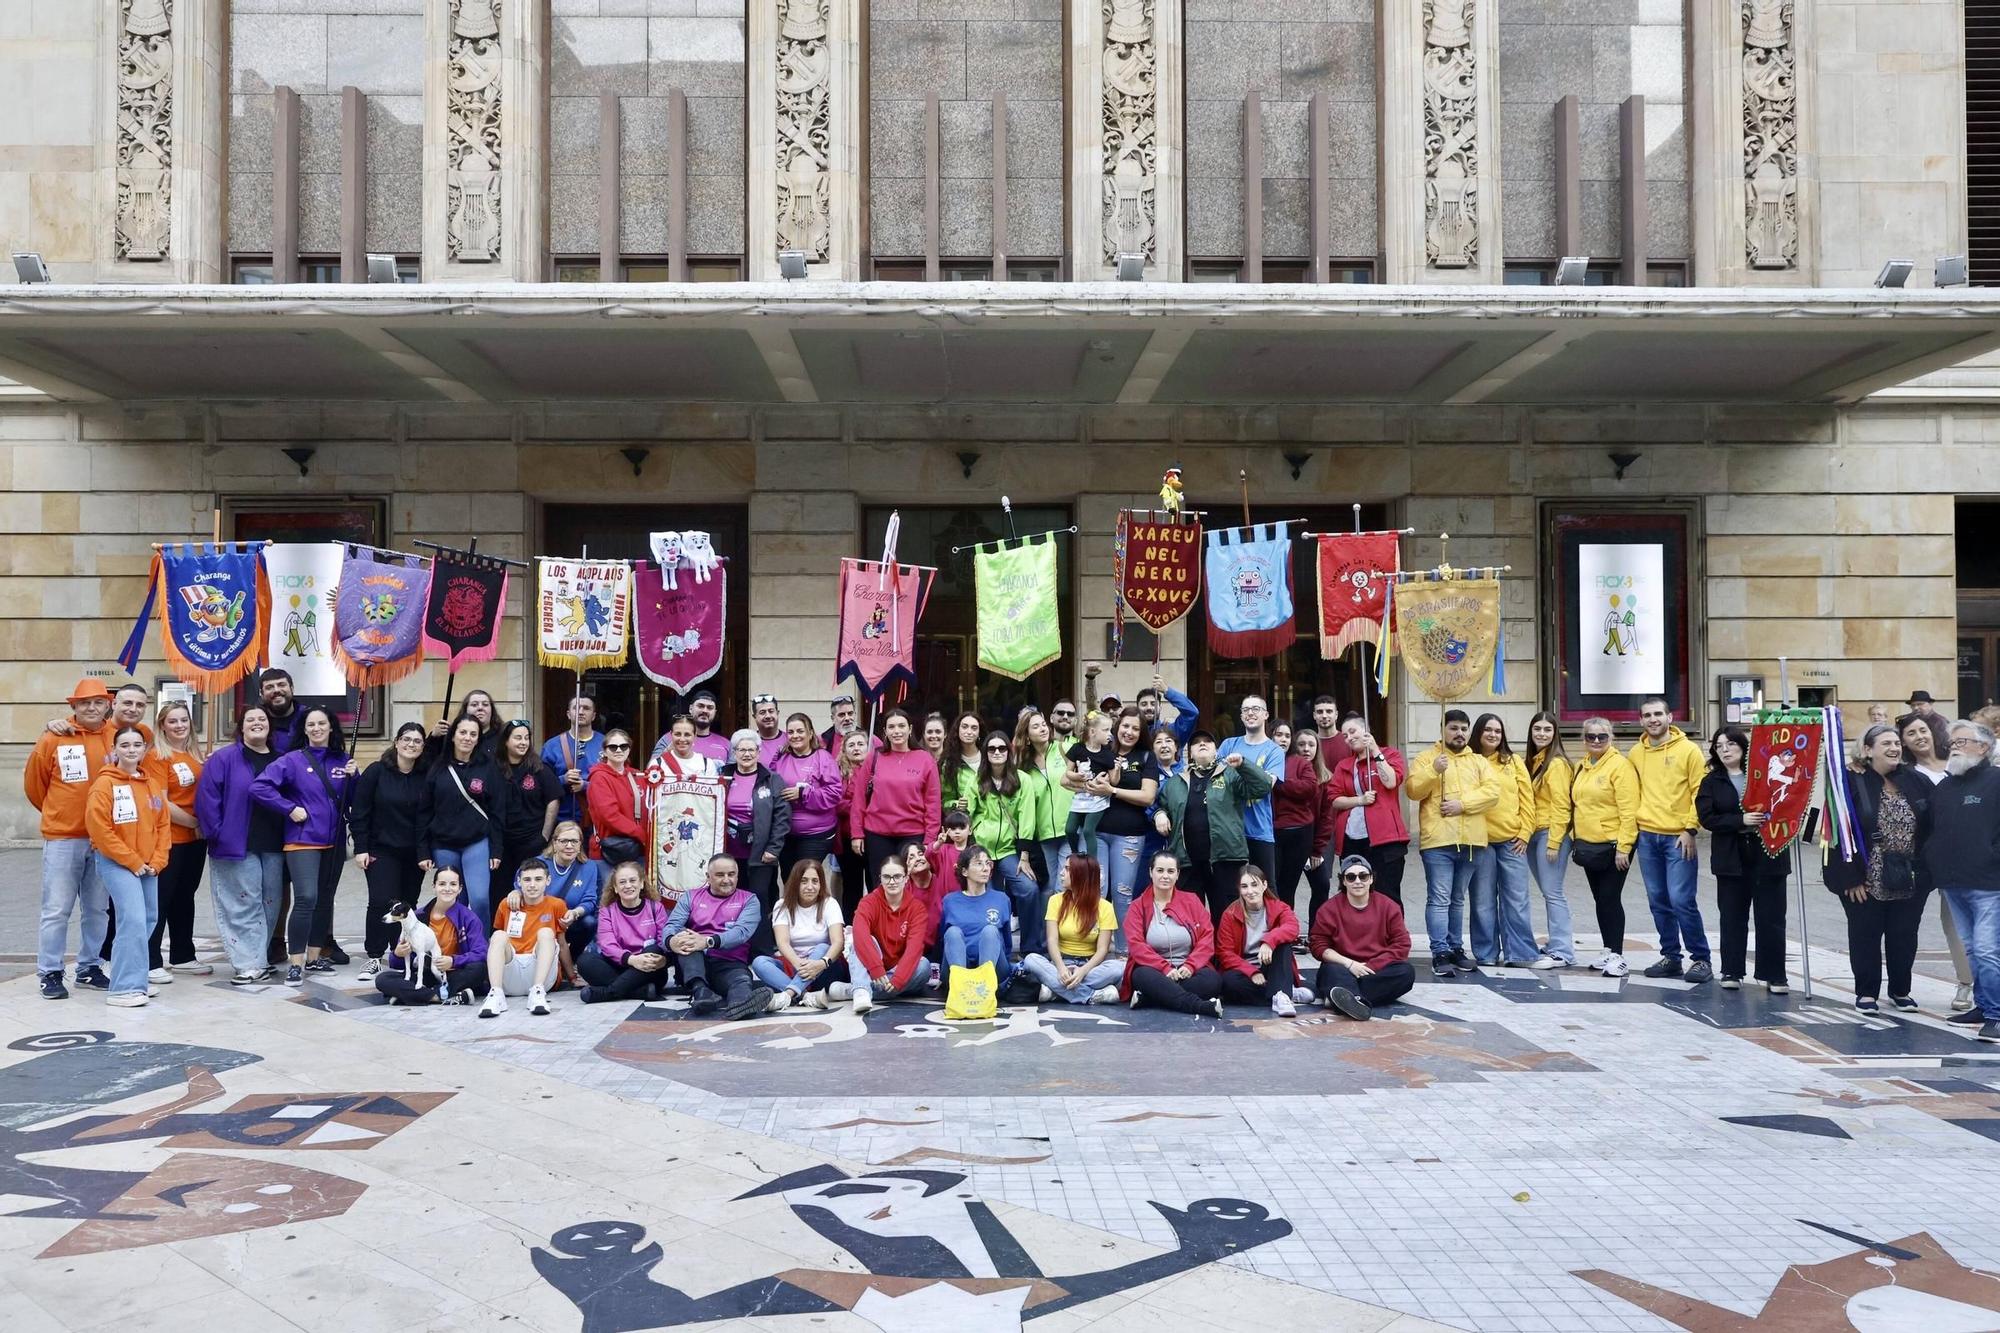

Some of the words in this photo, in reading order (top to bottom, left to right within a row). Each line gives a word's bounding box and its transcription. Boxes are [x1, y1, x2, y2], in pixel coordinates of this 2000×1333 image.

[1133, 526, 1194, 543] XAREU
[1145, 546, 1180, 563] NEL
[193, 572, 231, 583] Charanga
[547, 565, 567, 577] LOS
[1133, 561, 1187, 582] ÑERU
[447, 577, 487, 595] CHARANGA
[1127, 588, 1144, 600] C.P.
[1146, 587, 1191, 604] XOVE
[543, 590, 554, 633] PERCHERA
[1139, 607, 1179, 625] XIXON
[612, 623, 622, 636] LA
[560, 640, 585, 651] NUEVO
[663, 783, 713, 795] CHARANGA
